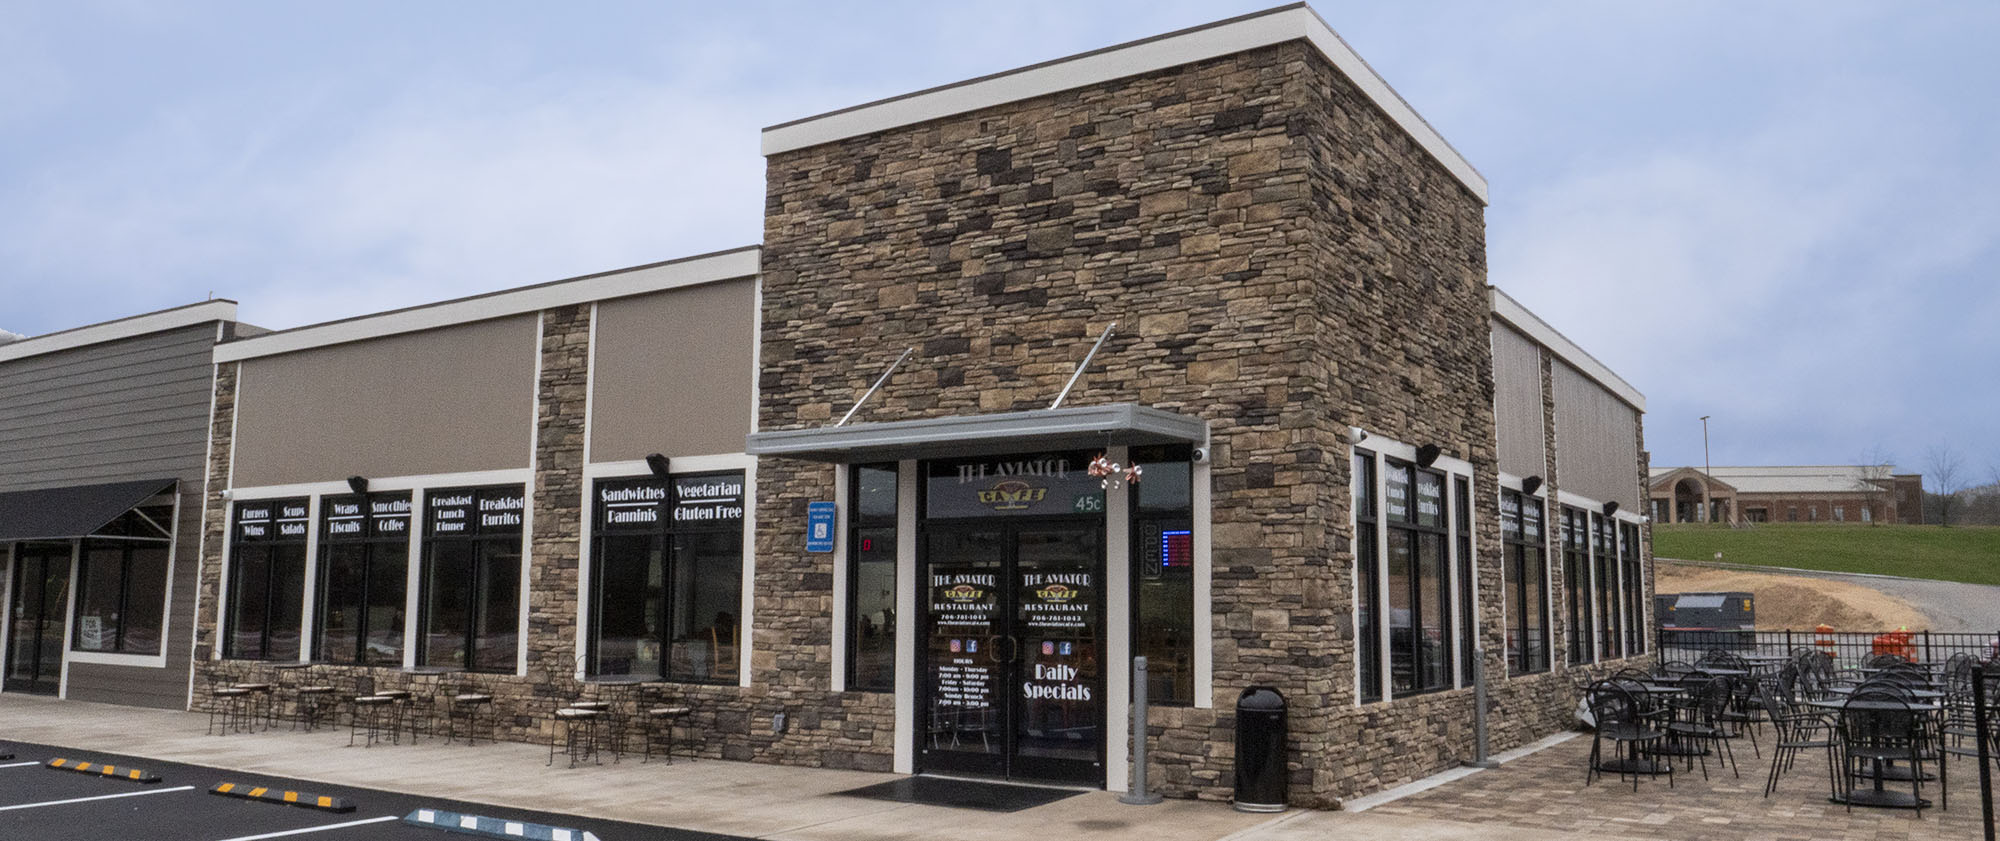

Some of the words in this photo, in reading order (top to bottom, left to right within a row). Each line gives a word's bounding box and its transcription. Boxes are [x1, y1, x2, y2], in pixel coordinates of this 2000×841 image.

[957, 464, 989, 484] THE
[993, 459, 1070, 480] AVIATOR
[601, 487, 665, 502] Sandwiches
[676, 482, 741, 498] Vegetarian
[432, 495, 472, 507] Breakfast
[480, 497, 524, 511] Breakfast
[242, 508, 268, 519] Burgers
[283, 505, 305, 517] Soups
[334, 503, 359, 515] Wraps
[438, 509, 465, 519] Lunch
[608, 508, 657, 523] Panninis
[674, 507, 713, 521] Gluten
[715, 505, 742, 519] Free
[379, 519, 404, 532] Coffee
[482, 513, 520, 526] Burritos
[244, 525, 264, 536] Wings
[281, 523, 305, 535] Salads
[330, 521, 360, 534] Biscuits
[436, 522, 465, 531] Dinner
[934, 575, 951, 587] THE
[953, 574, 996, 587] AVIATOR
[1024, 574, 1043, 587] THE
[1045, 573, 1091, 587] AVIATOR
[1035, 664, 1078, 681] Daily
[1024, 681, 1091, 701] Specials
